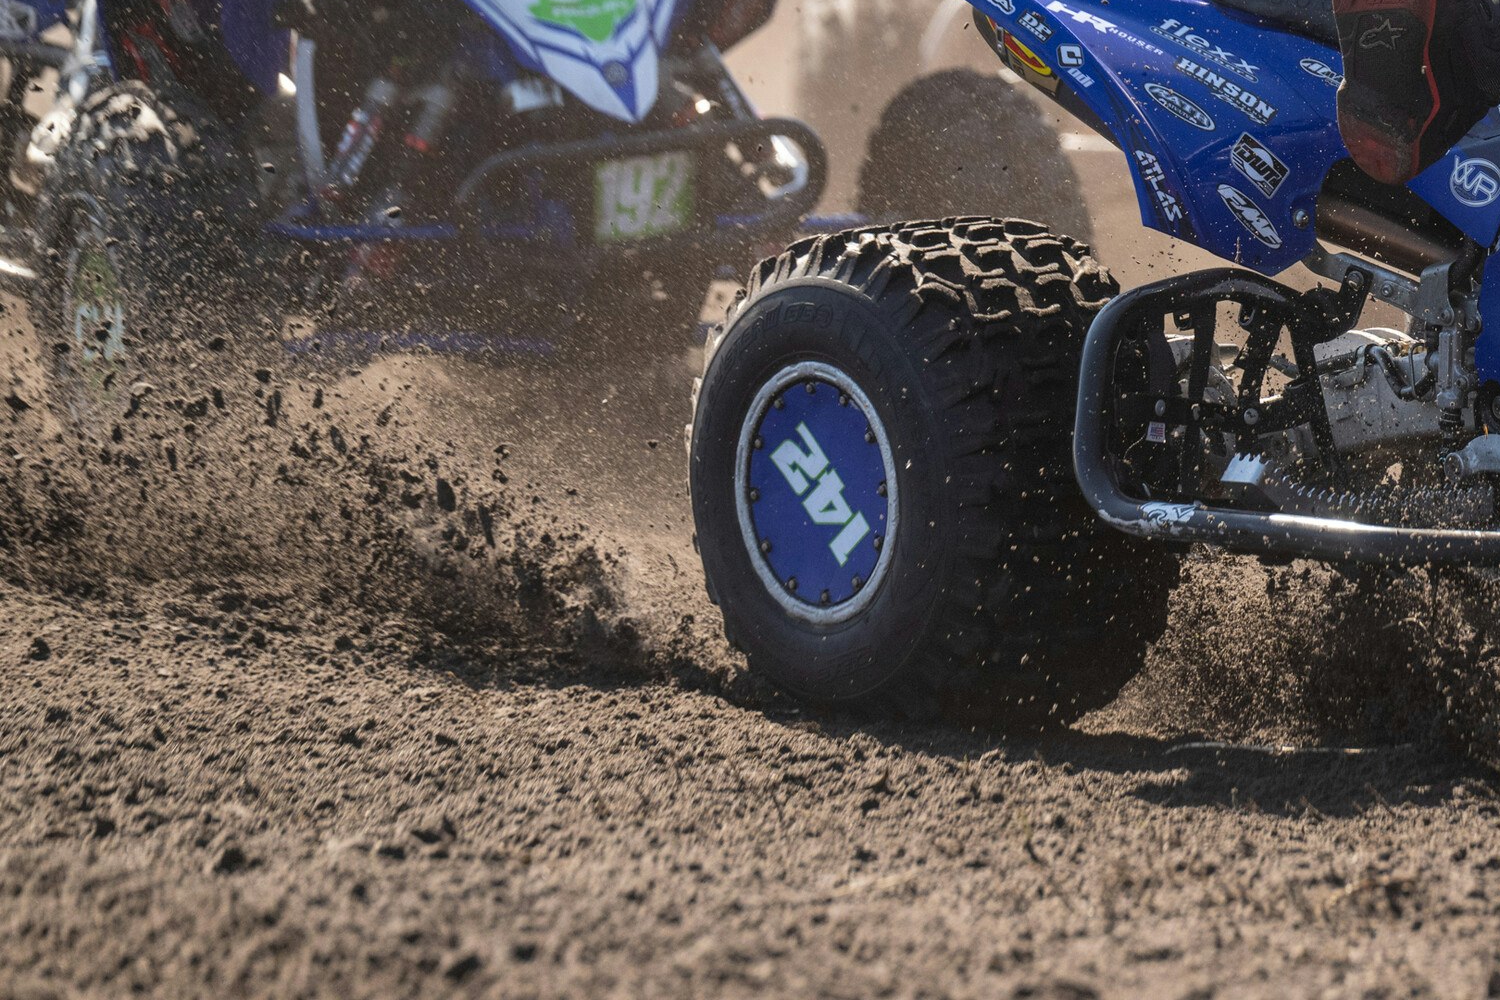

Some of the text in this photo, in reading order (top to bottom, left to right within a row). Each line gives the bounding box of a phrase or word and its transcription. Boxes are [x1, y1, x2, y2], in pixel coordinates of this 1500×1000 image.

[1109, 27, 1164, 55] HOUSER
[1159, 18, 1260, 74] flexx
[1177, 57, 1276, 120] HINSON
[598, 153, 690, 234] 192
[1135, 150, 1183, 222] ATLAS
[1217, 185, 1284, 246] FMF
[769, 421, 870, 568] 142
